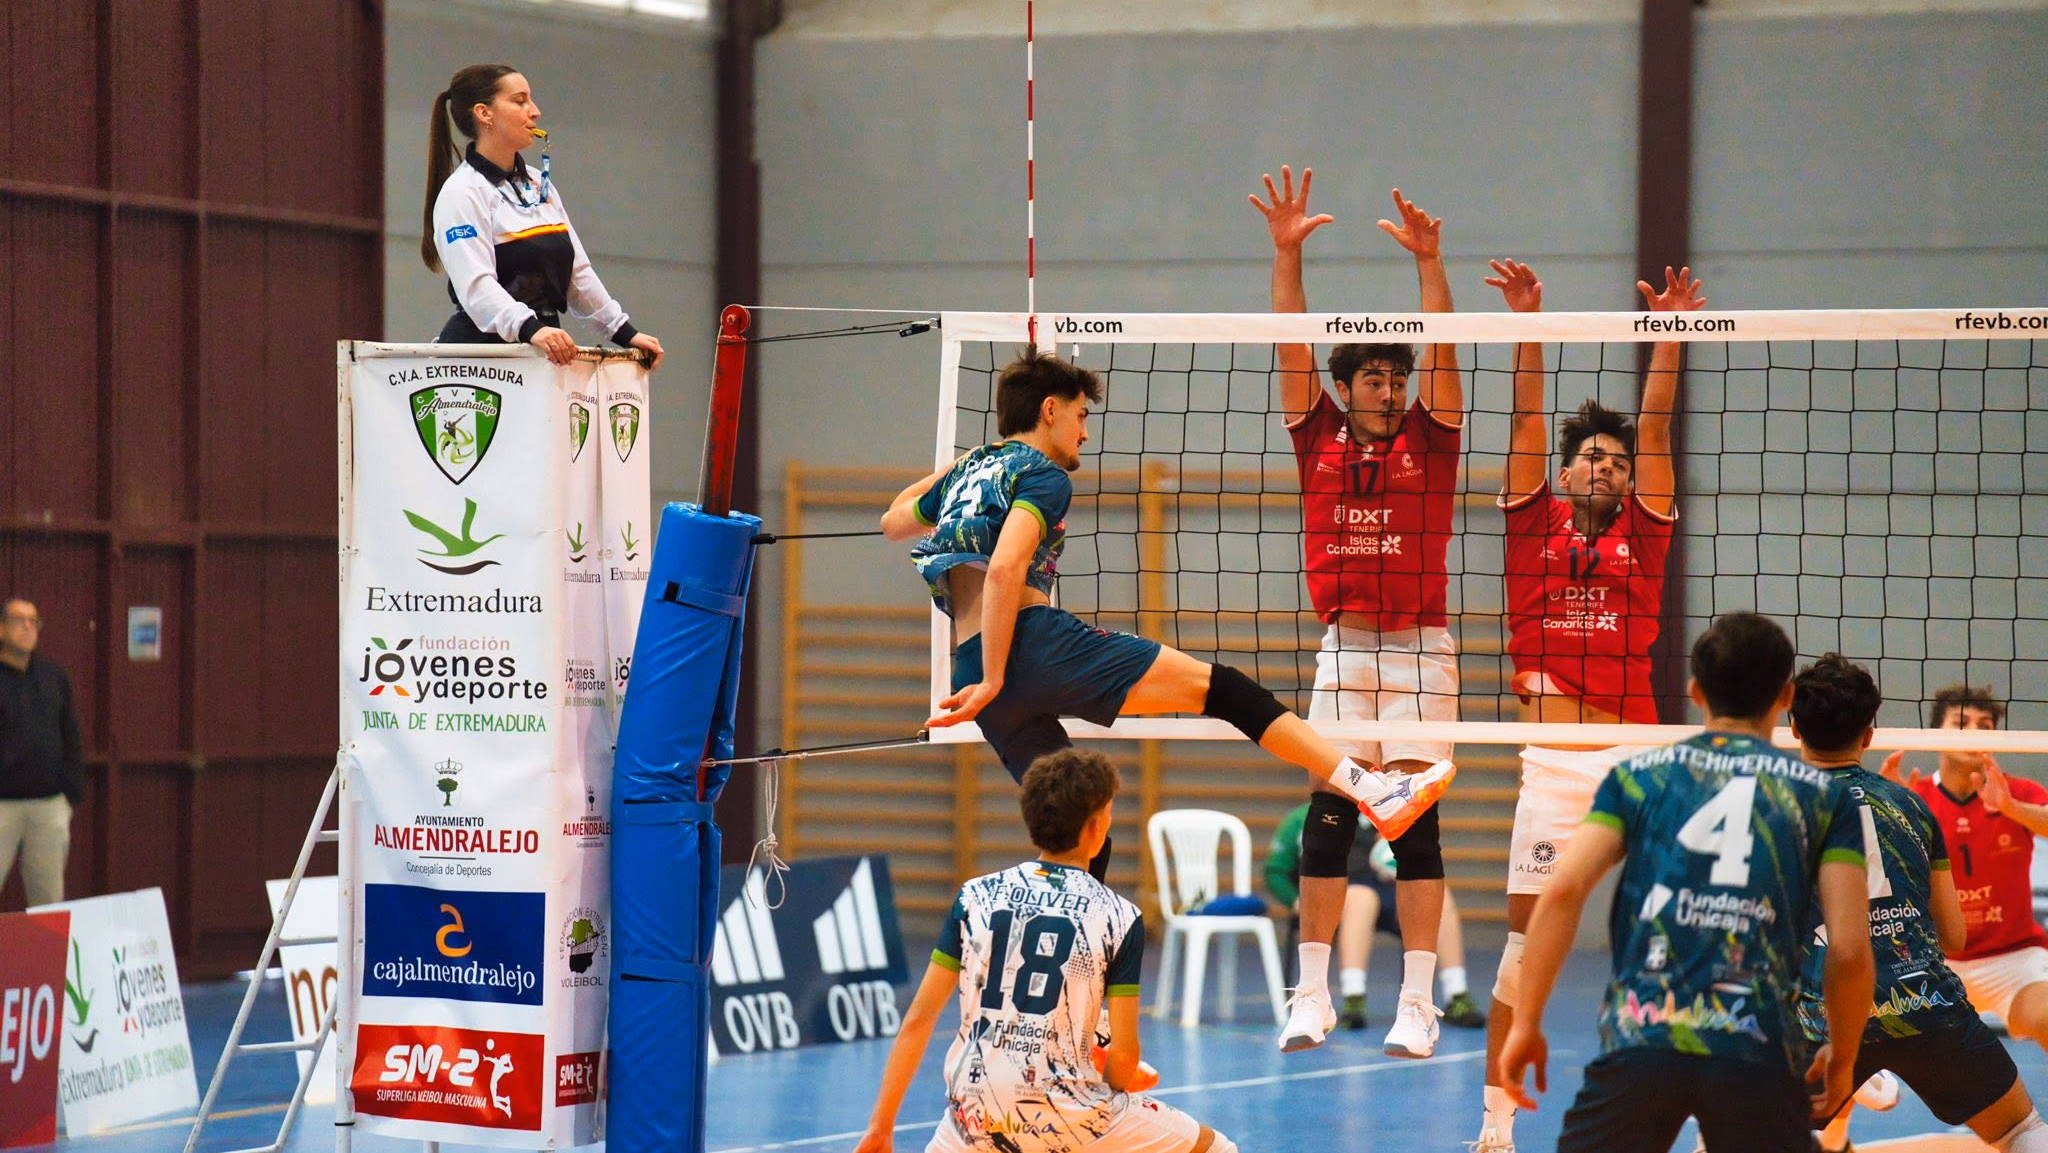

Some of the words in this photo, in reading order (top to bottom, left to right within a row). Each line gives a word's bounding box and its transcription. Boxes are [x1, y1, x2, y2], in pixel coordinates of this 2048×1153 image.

[449, 226, 473, 239] TSK
[1028, 317, 1122, 333] vb.com
[1325, 317, 1424, 333] rfevb.com
[1633, 315, 1736, 332] rfevb.com
[388, 369, 422, 386] C.V.A.
[426, 365, 523, 386] EXTREMADURA
[416, 397, 498, 420] Almendralejo
[1349, 461, 1380, 498] 17
[1349, 509, 1393, 524] DXT
[1350, 535, 1379, 545] Islas
[1326, 544, 1379, 555] Canarias
[1568, 547, 1600, 580] 12
[365, 586, 543, 613] Extremadura
[1565, 586, 1609, 600] DXT
[1543, 618, 1595, 629] Canarias
[419, 635, 510, 650] fundación
[362, 711, 399, 731] JUNTA
[408, 712, 427, 730] DE
[435, 713, 546, 732] EXTREMADURA
[414, 815, 484, 827] AYUNTAMIENTO
[563, 822, 612, 836] ALMENDRALE
[374, 824, 539, 854] ALMENDRALEJO
[1676, 776, 1758, 888] 4
[1526, 864, 1555, 874] LAGU
[1959, 844, 1973, 877] 1
[445, 864, 454, 875] de
[456, 863, 491, 877] Deportes
[1868, 904, 1921, 922] dación
[1869, 919, 1904, 938] icaja
[980, 908, 1077, 1015] 18
[373, 956, 535, 995] cajalmendralejo
[560, 976, 604, 988] VOLEIBOL
[992, 1034, 1040, 1057] Unicaja
[379, 1044, 480, 1086] SM-2
[376, 1089, 416, 1102] SUPERLIGA
[444, 1093, 487, 1109] MASCULINA
